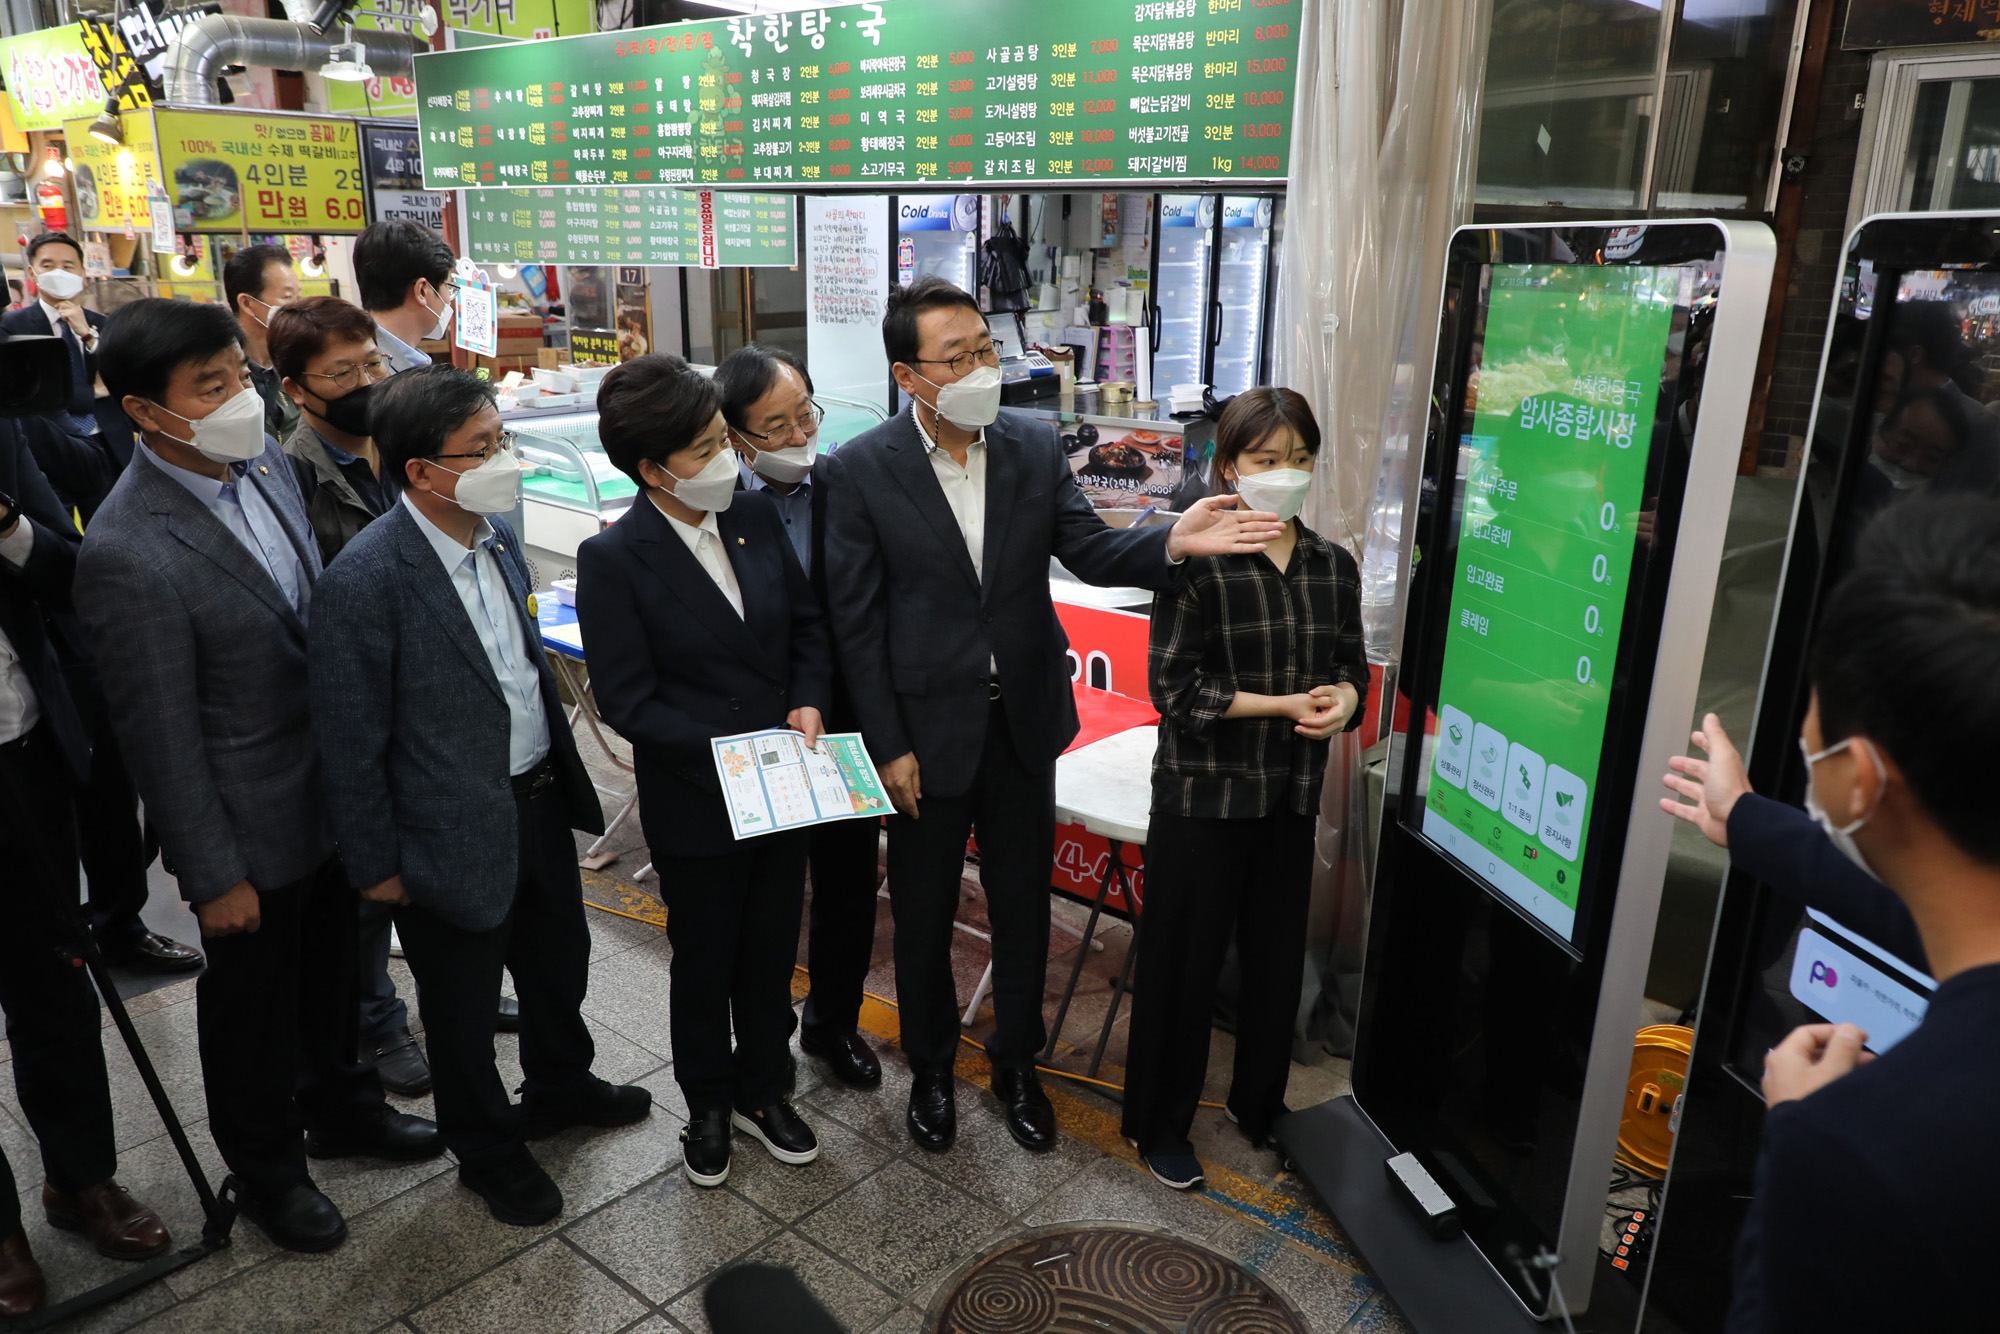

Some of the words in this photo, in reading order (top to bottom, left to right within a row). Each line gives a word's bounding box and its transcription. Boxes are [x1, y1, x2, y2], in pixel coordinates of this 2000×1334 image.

[1135, 0, 1196, 22] 감자닭볶음탕
[1209, 0, 1241, 13] 한마리
[1133, 31, 1194, 52] 묵은지닭볶음탕
[1207, 30, 1239, 46] 반마리
[1255, 24, 1288, 41] 8,000
[1052, 44, 1076, 57] 3인분
[1091, 40, 1118, 54] 7,000
[918, 55, 938, 68] 2인분
[950, 52, 974, 65] 5,000
[800, 66, 818, 78] 2인분
[829, 63, 850, 74] 6,000
[1132, 63, 1193, 83] 묵은지닭볶음탕
[1205, 62, 1237, 78] 한마리
[1247, 58, 1286, 74] 15,000
[698, 75, 715, 86] 2인분
[724, 73, 742, 83] 7,000
[917, 83, 938, 95] 2인분
[949, 80, 973, 92] 5,000
[986, 74, 1038, 91] 고기설렁탕
[1052, 74, 1076, 87] 3인분
[1083, 70, 1116, 84] 11,000
[801, 91, 819, 103] 2인분
[829, 89, 850, 100] 8,000
[1130, 94, 1190, 113] 뼈없는닭갈비
[1207, 94, 1235, 108] 3인분
[1244, 91, 1283, 107] 10,000
[699, 99, 716, 110] 2인분
[985, 103, 1037, 119] 도가니설렁탕
[1051, 103, 1074, 116] 3인분
[1083, 100, 1115, 113] 12,000
[801, 117, 819, 128] 2인분
[829, 114, 850, 126] 8,000
[917, 110, 937, 122] 2인분
[949, 107, 973, 120] 5,000
[276, 128, 307, 141] 없으면
[700, 123, 716, 134] 3인분
[1129, 125, 1189, 143] 버섯불고기전골
[1205, 126, 1233, 140] 3인분
[1243, 124, 1281, 139] 13,000
[861, 136, 905, 152] 황태해장국
[917, 137, 937, 148] 2인분
[949, 135, 972, 147] 6,000
[985, 131, 1035, 147] 고등어조림
[1050, 132, 1073, 145] 3인분
[1081, 130, 1114, 143] 10,000
[180, 140, 216, 154] 100%
[222, 141, 262, 157] 국내산
[268, 144, 294, 158] 수제
[701, 146, 717, 157] 3인분
[754, 141, 791, 156] 고추장불고기
[830, 140, 850, 151] 8,000
[802, 167, 819, 177] 3인분
[830, 165, 850, 175] 9,000
[861, 162, 904, 176] 소고기무국
[917, 163, 936, 175] 2인분
[948, 162, 972, 174] 5,000
[1049, 161, 1072, 173] 3인분
[1081, 159, 1113, 172] 12,000
[1128, 156, 1186, 172] 돼지갈비찜
[1213, 157, 1231, 172] 1kg
[1241, 156, 1279, 170] 14,000
[246, 164, 308, 188] 4인분
[702, 169, 718, 180] 2인분
[258, 190, 308, 219] 만원
[901, 204, 930, 219] Cold
[928, 206, 948, 219] Drinks
[1162, 204, 1181, 217] Cold
[1224, 206, 1242, 218] Cold
[624, 270, 637, 282] 17
[1520, 396, 1637, 449] 암사종합시장
[1073, 473, 1140, 494] 지해장국(2인분)
[1472, 519, 1512, 548] 입고준비
[1466, 564, 1504, 594] 입고완료
[1460, 608, 1489, 636] 클레임
[1545, 825, 1572, 850] 공지사항
